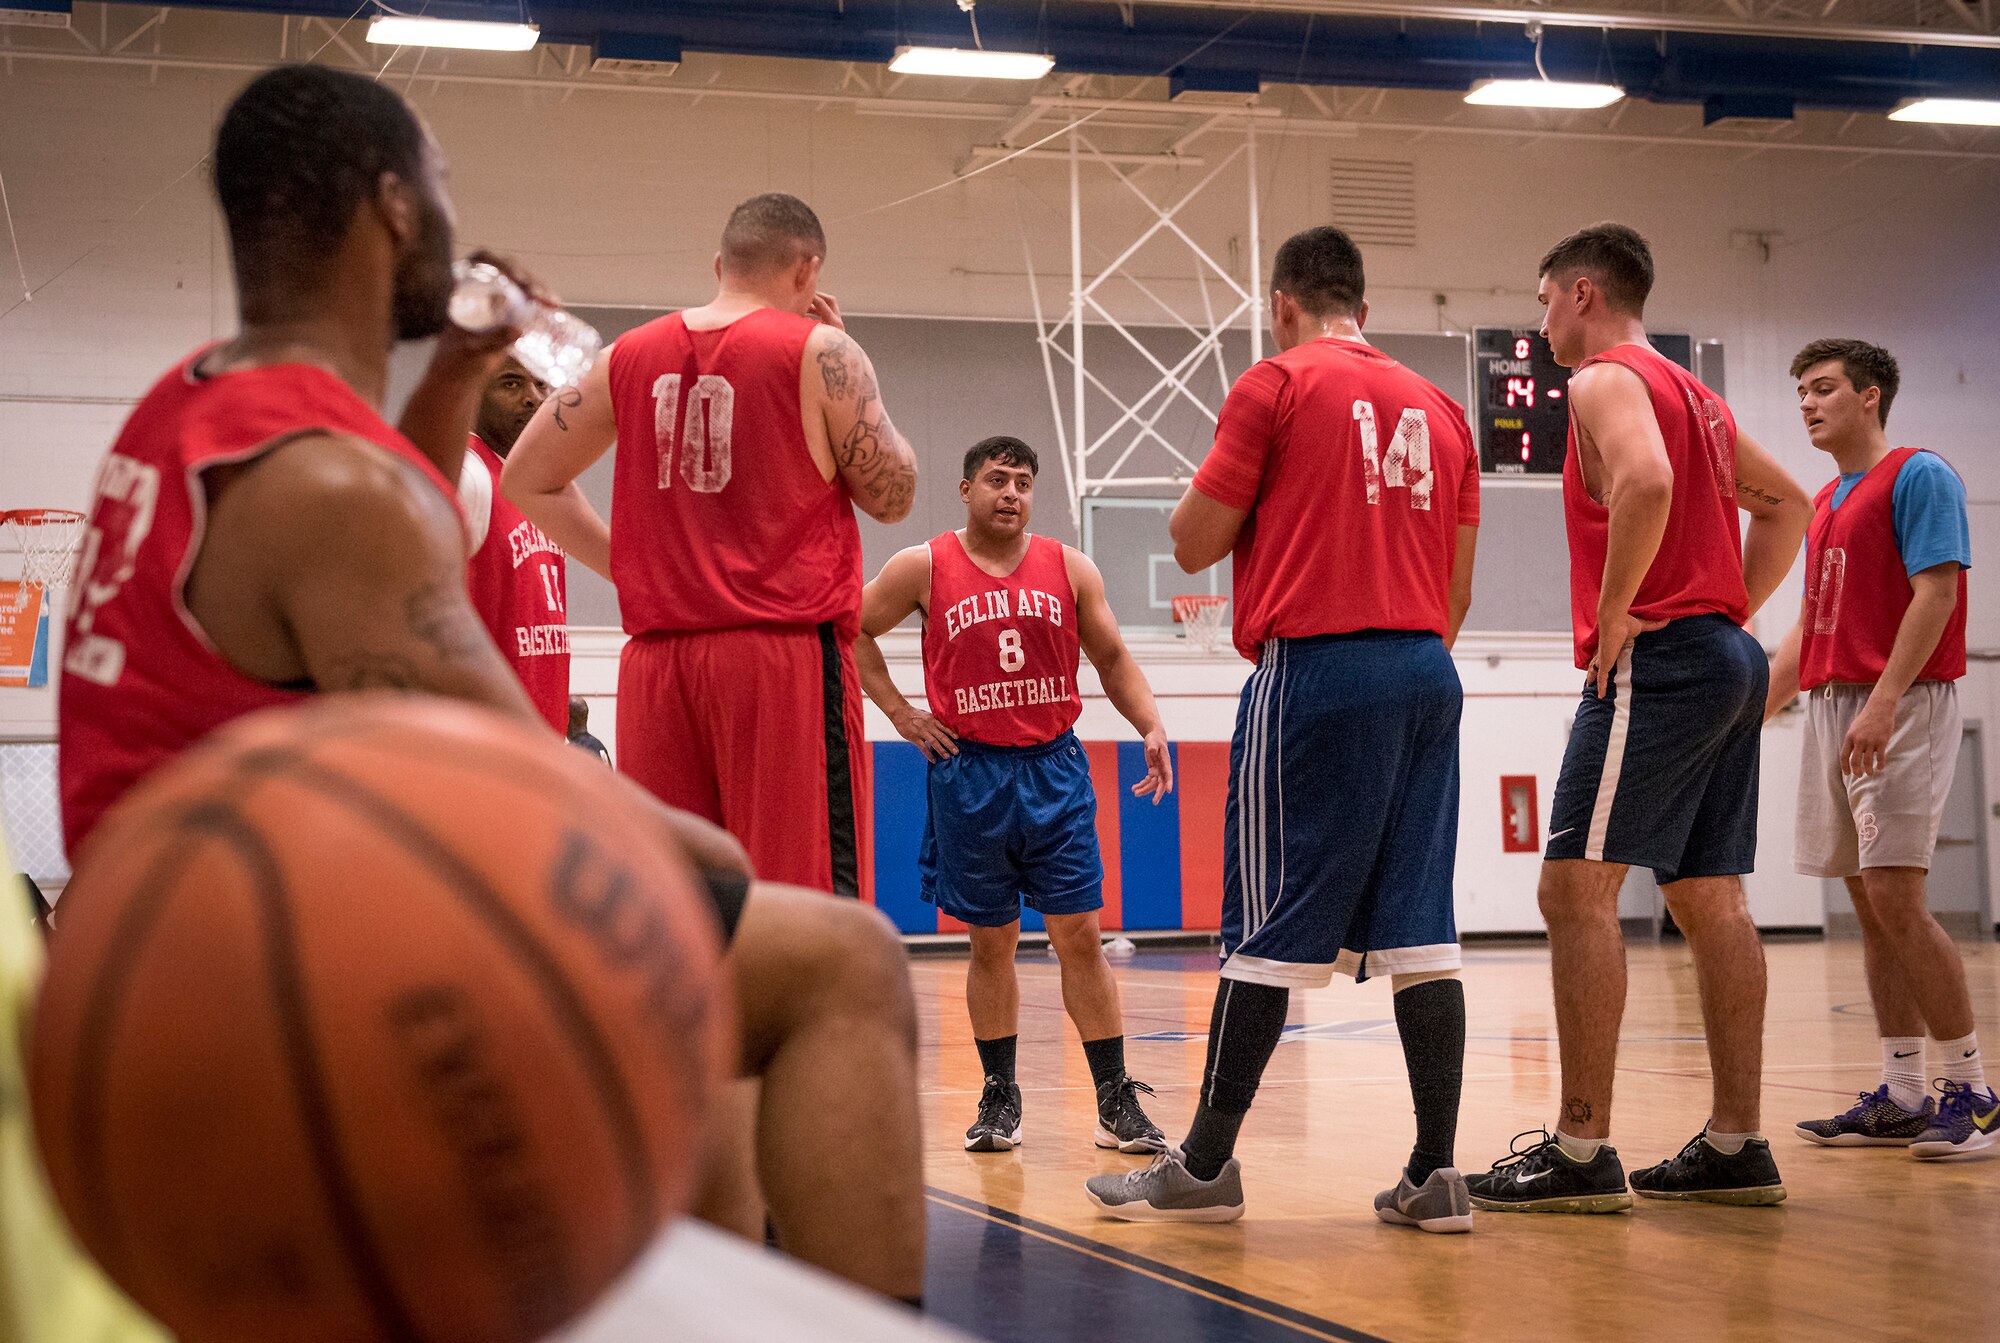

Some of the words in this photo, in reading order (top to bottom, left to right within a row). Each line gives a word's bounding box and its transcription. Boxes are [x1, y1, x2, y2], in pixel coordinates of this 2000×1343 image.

[1489, 360, 1532, 376] HOME
[1507, 377, 1535, 407] 14
[651, 373, 735, 493] 10
[1521, 431, 1531, 462] 1
[1352, 399, 1434, 511] 14
[945, 589, 1011, 642] EGLIN
[1017, 588, 1062, 628] AFB
[998, 628, 1025, 673] 8
[954, 675, 1071, 715] BASKETBALL
